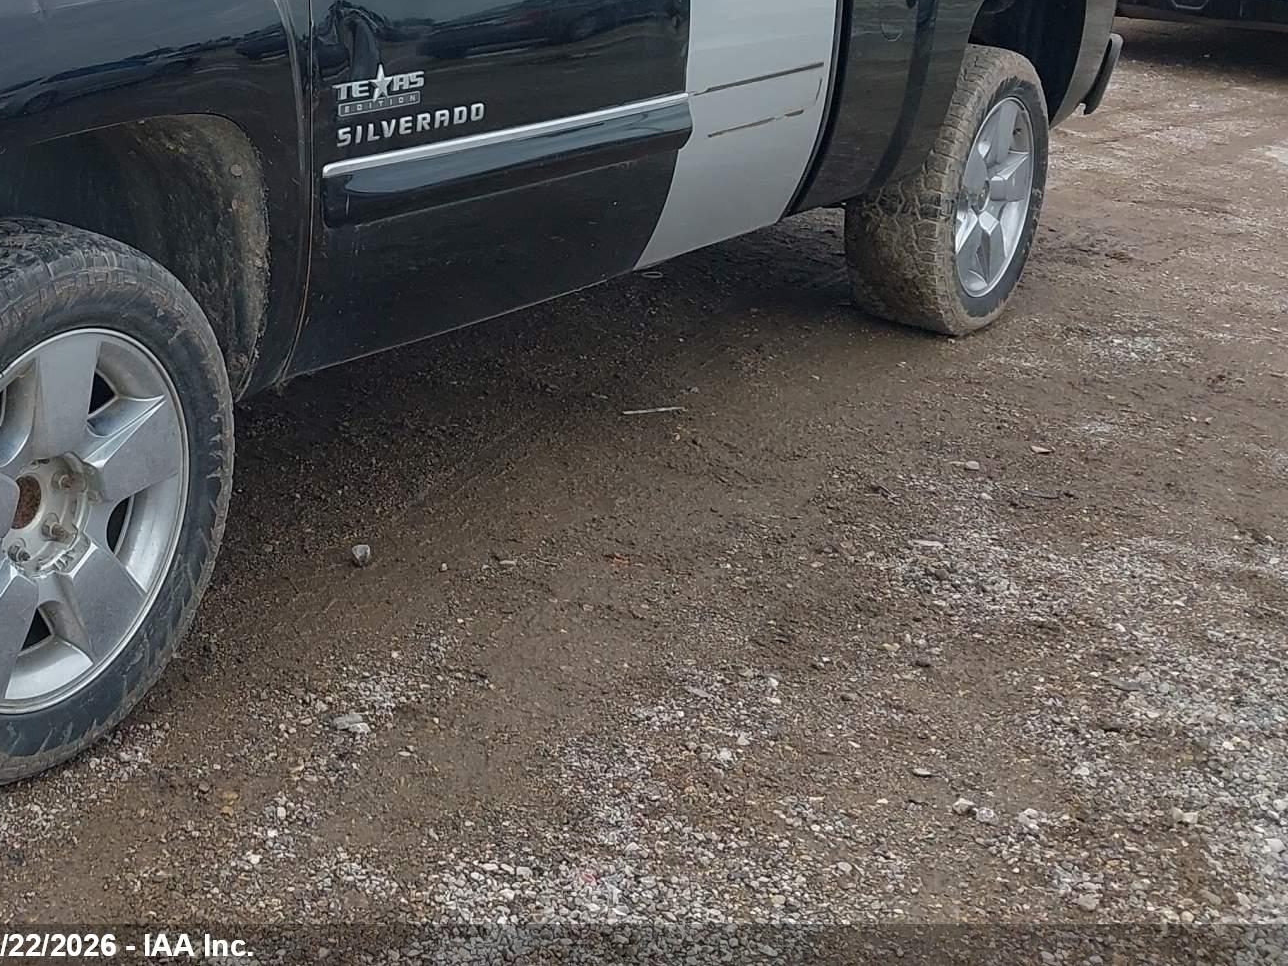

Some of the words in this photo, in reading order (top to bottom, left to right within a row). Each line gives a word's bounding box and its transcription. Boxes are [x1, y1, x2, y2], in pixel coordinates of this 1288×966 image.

[332, 64, 425, 102] TEXAS
[344, 94, 416, 113] EDITION
[336, 102, 485, 148] SILVERADO
